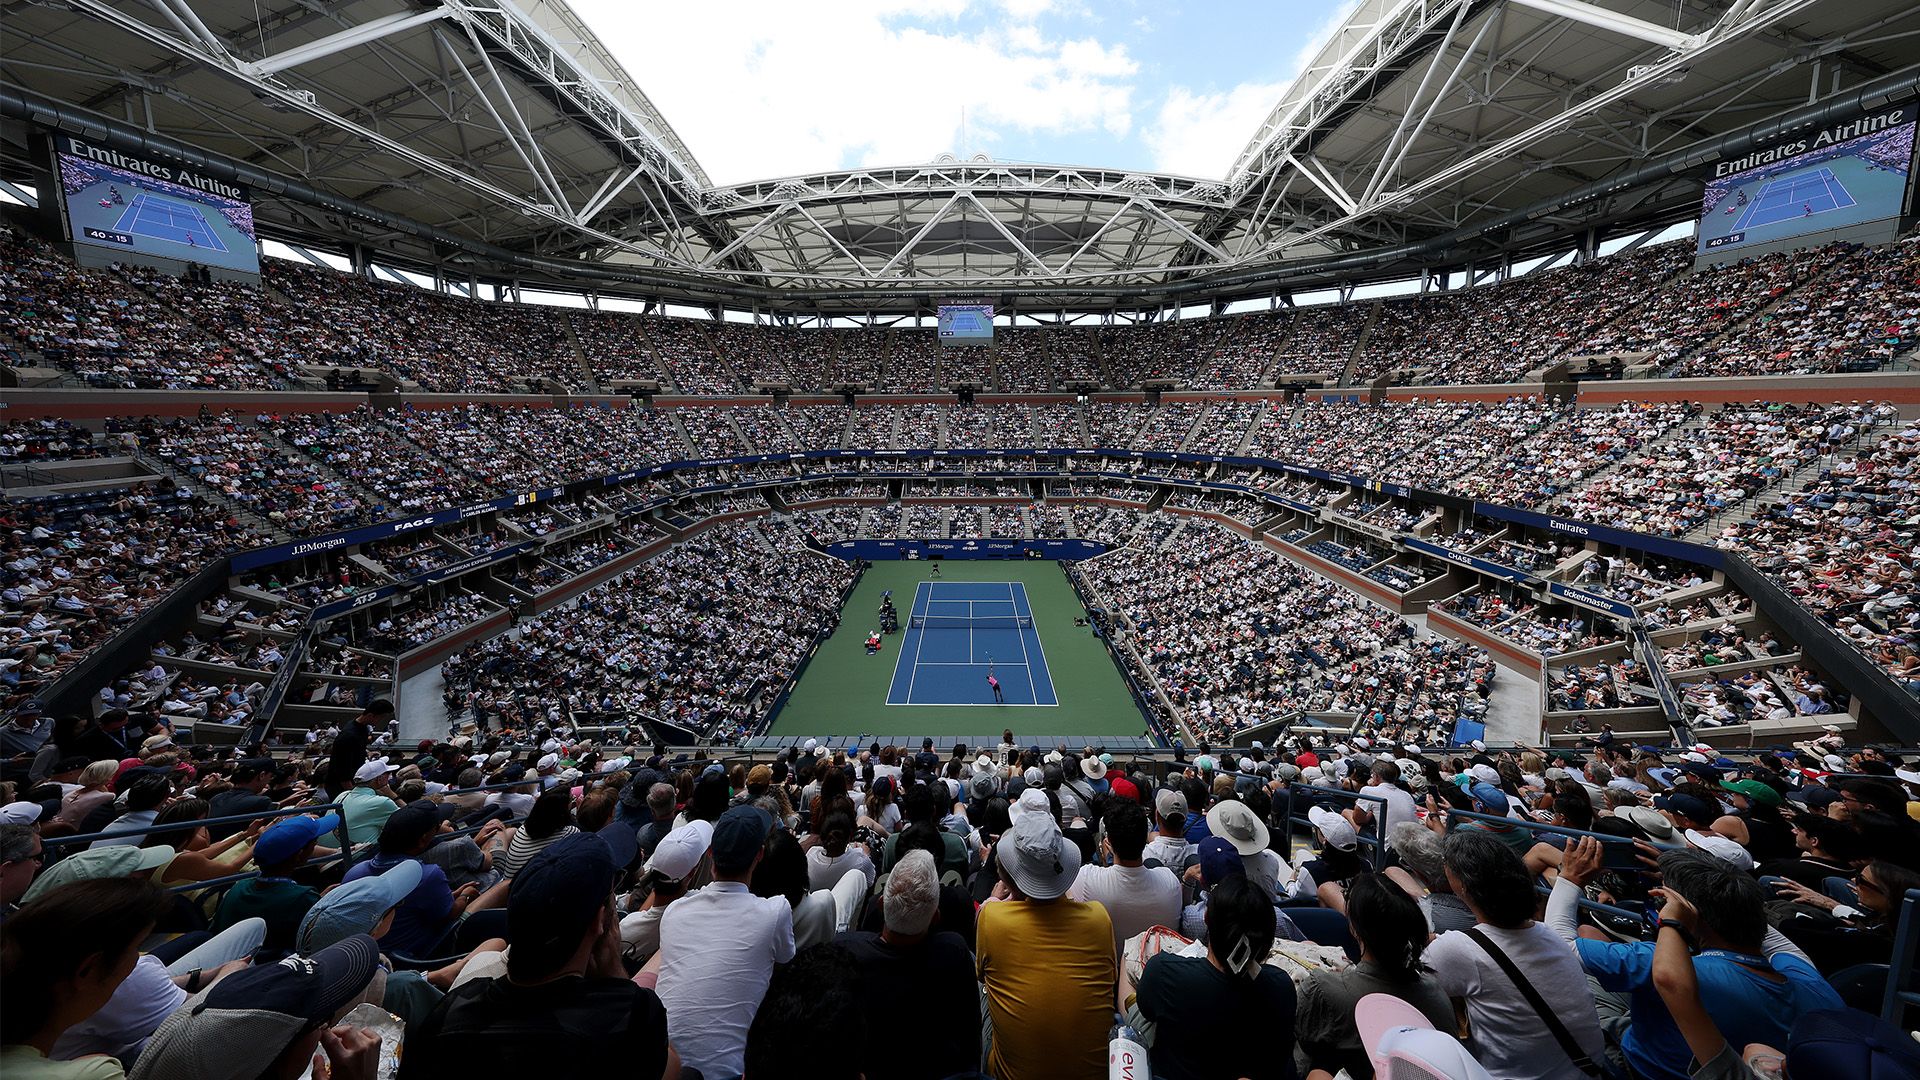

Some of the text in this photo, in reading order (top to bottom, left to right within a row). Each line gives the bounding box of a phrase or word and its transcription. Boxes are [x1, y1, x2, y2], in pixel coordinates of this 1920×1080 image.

[1716, 110, 1904, 177] Emirates Airline
[68, 137, 242, 200] Emirates Airline
[91, 230, 106, 238] 40
[1550, 520, 1589, 535] Emirates
[292, 537, 345, 555] J.P.Morgan
[444, 556, 492, 575] AMERICAN EXPRESS
[1448, 552, 1472, 564] CHASE
[352, 592, 377, 607] ATP
[1564, 589, 1613, 610] ticketmaster
